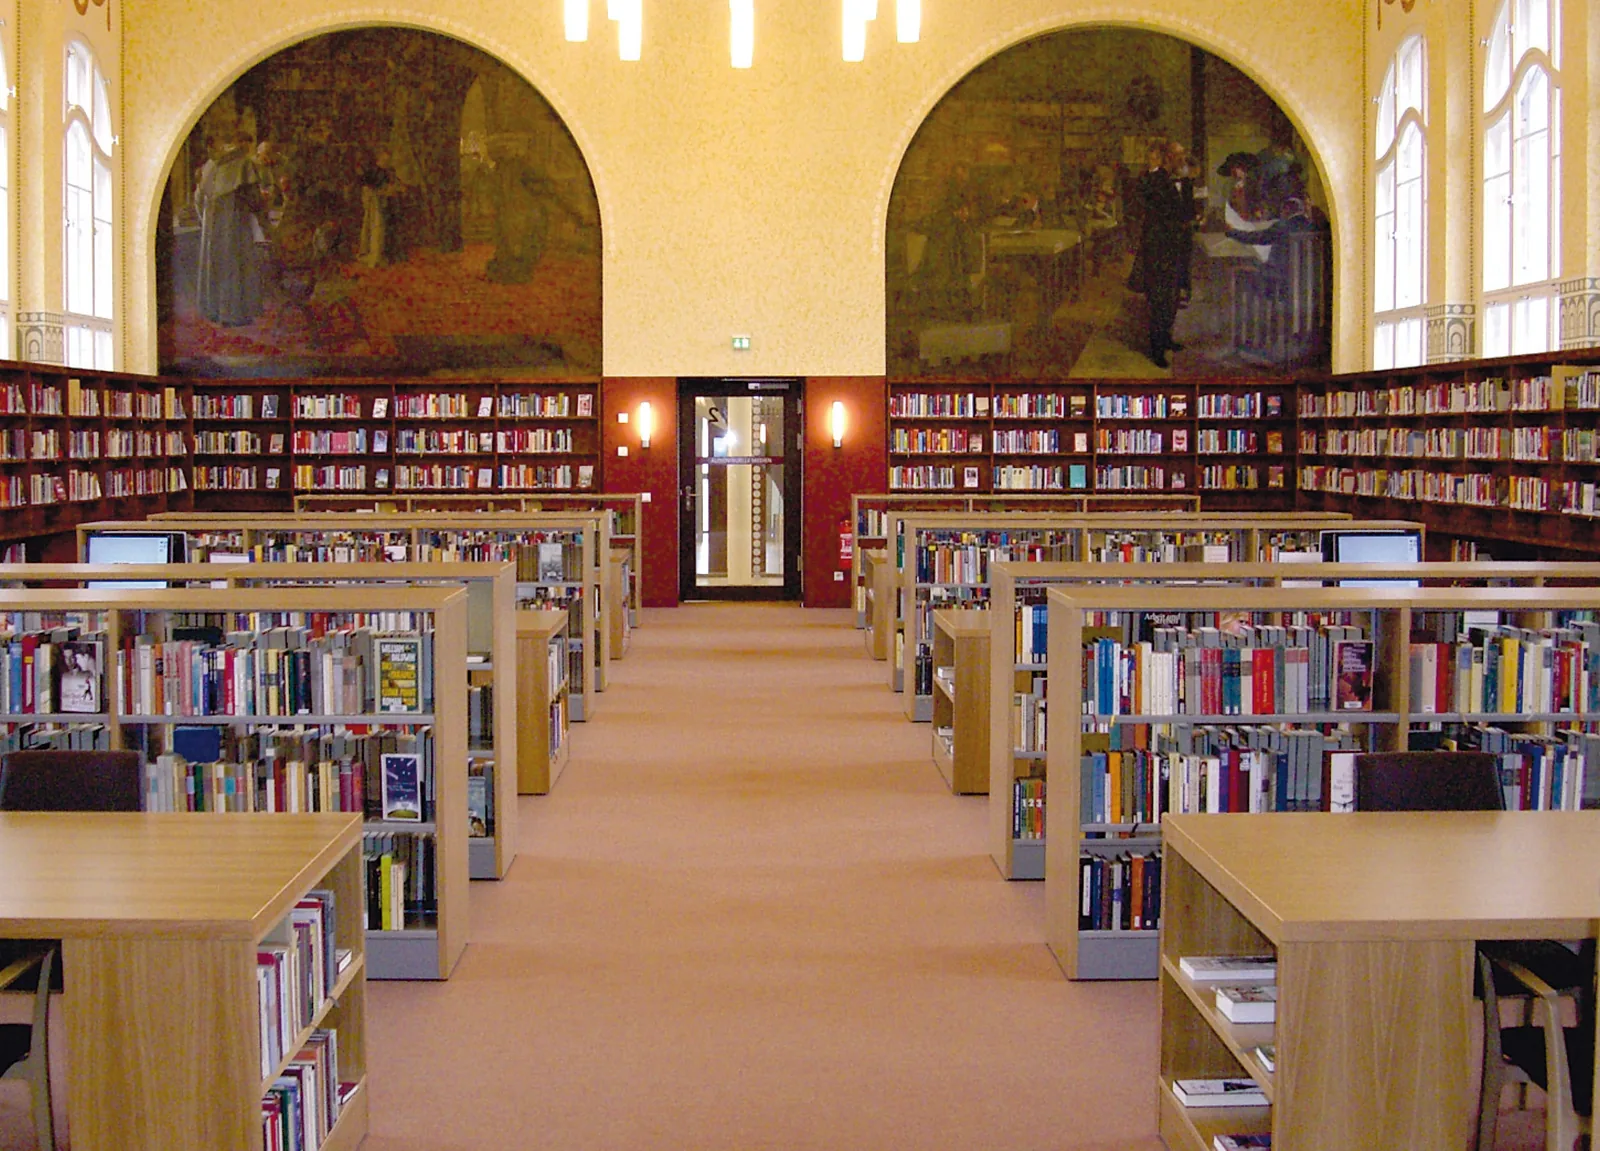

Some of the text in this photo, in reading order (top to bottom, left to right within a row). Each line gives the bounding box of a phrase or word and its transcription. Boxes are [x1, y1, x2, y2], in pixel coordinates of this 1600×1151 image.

[1022, 798, 1027, 807] 1
[1028, 798, 1034, 807] 2
[1036, 798, 1042, 808] 3
